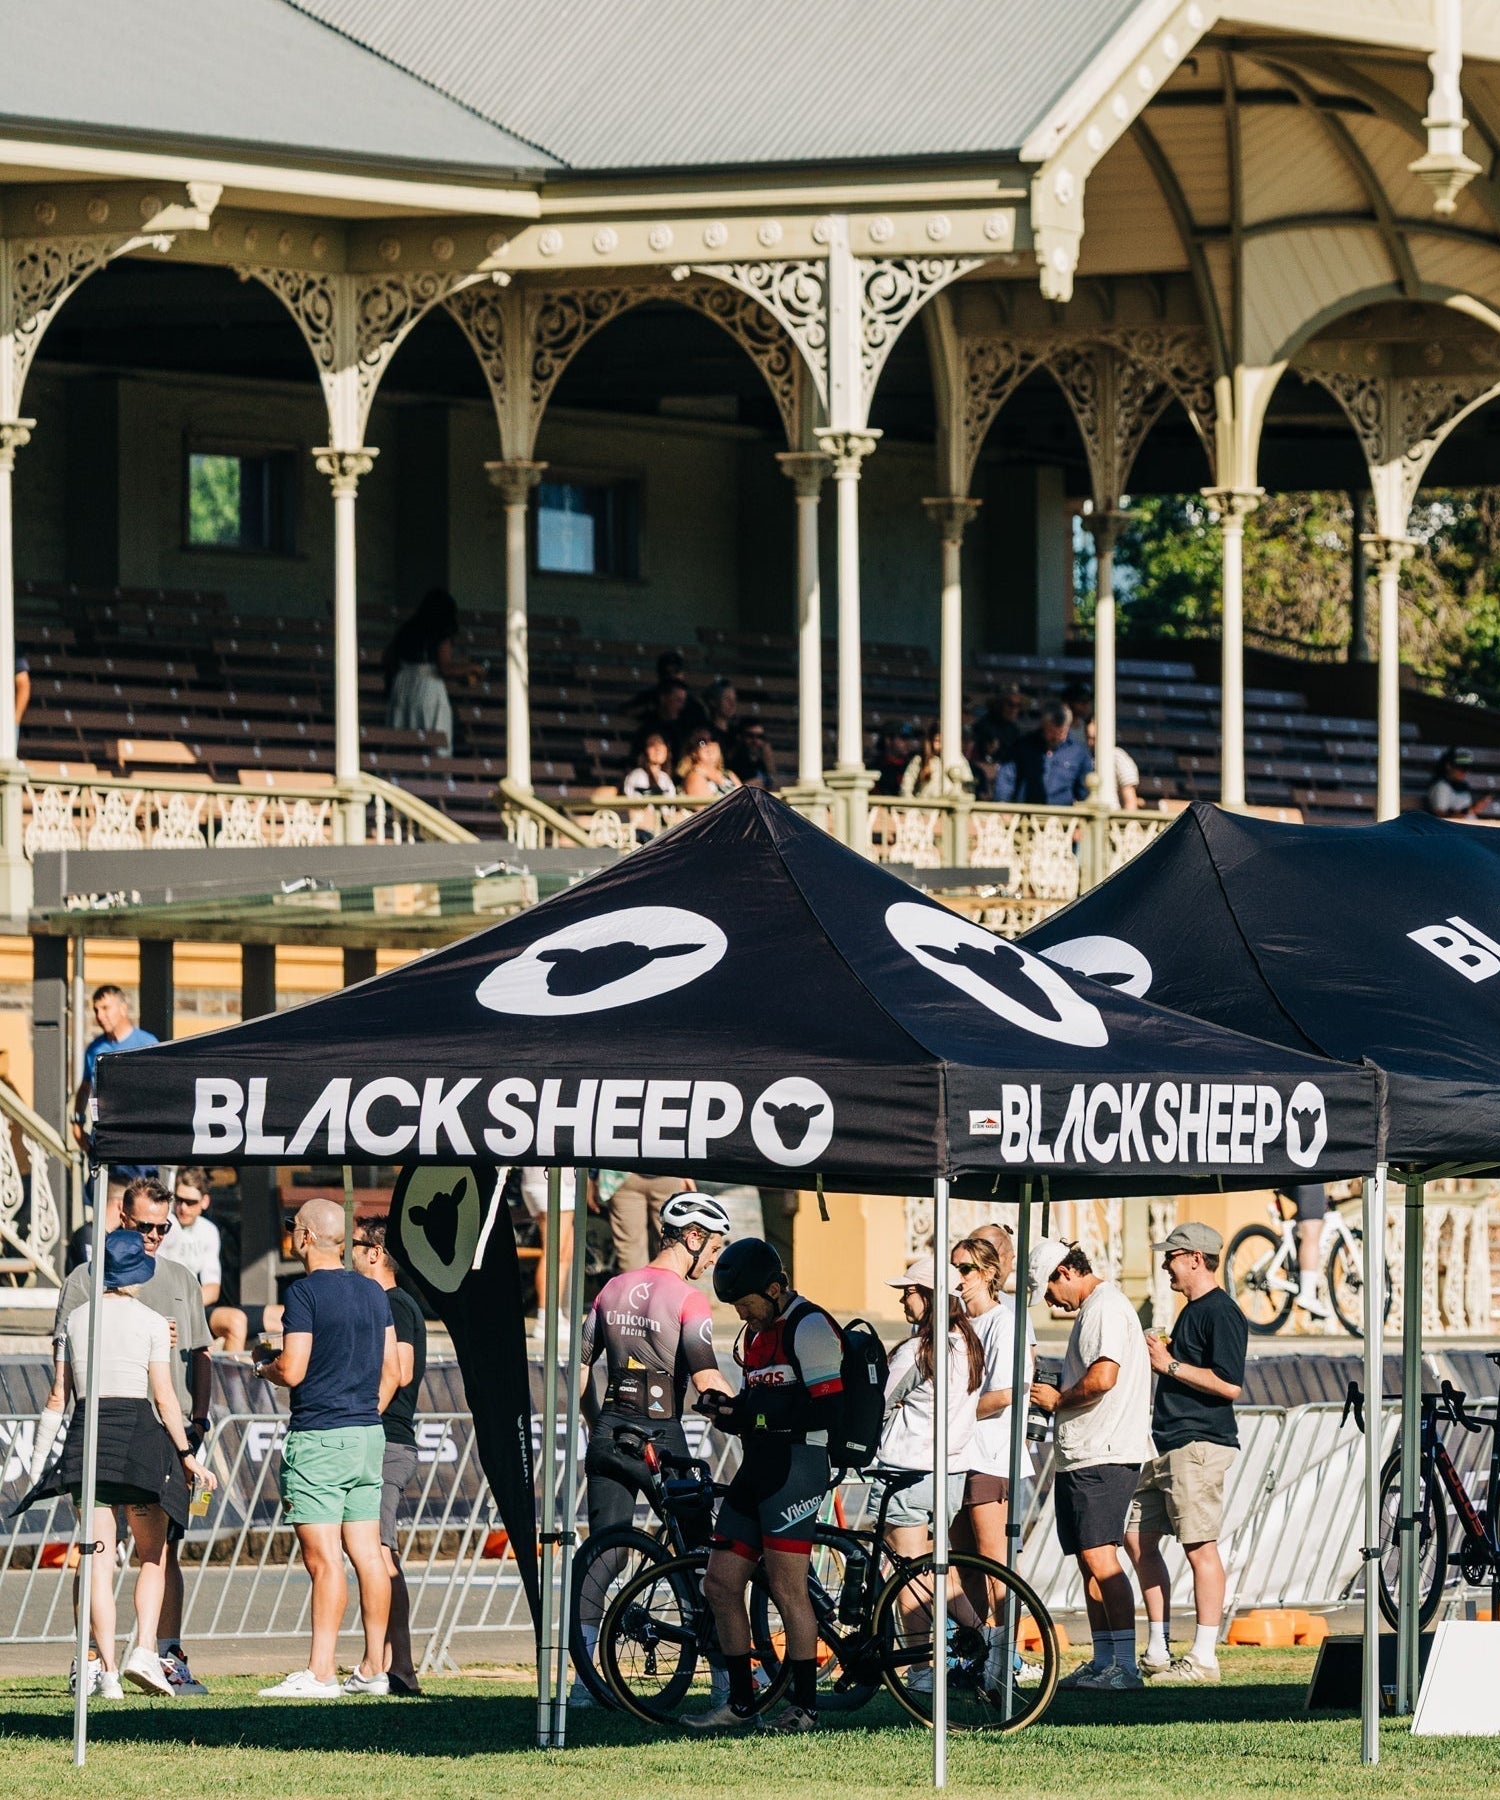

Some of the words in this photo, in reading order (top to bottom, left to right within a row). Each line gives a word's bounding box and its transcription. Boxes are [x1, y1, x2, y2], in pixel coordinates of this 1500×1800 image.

[191, 1076, 482, 1156] BLACK
[483, 1077, 744, 1159] SHEEP
[1000, 1082, 1151, 1163] BLACK
[1151, 1081, 1283, 1164] SHEEP
[606, 1310, 661, 1333] Unicorn
[620, 1326, 647, 1338] RACING
[780, 1494, 823, 1523] Vikings
